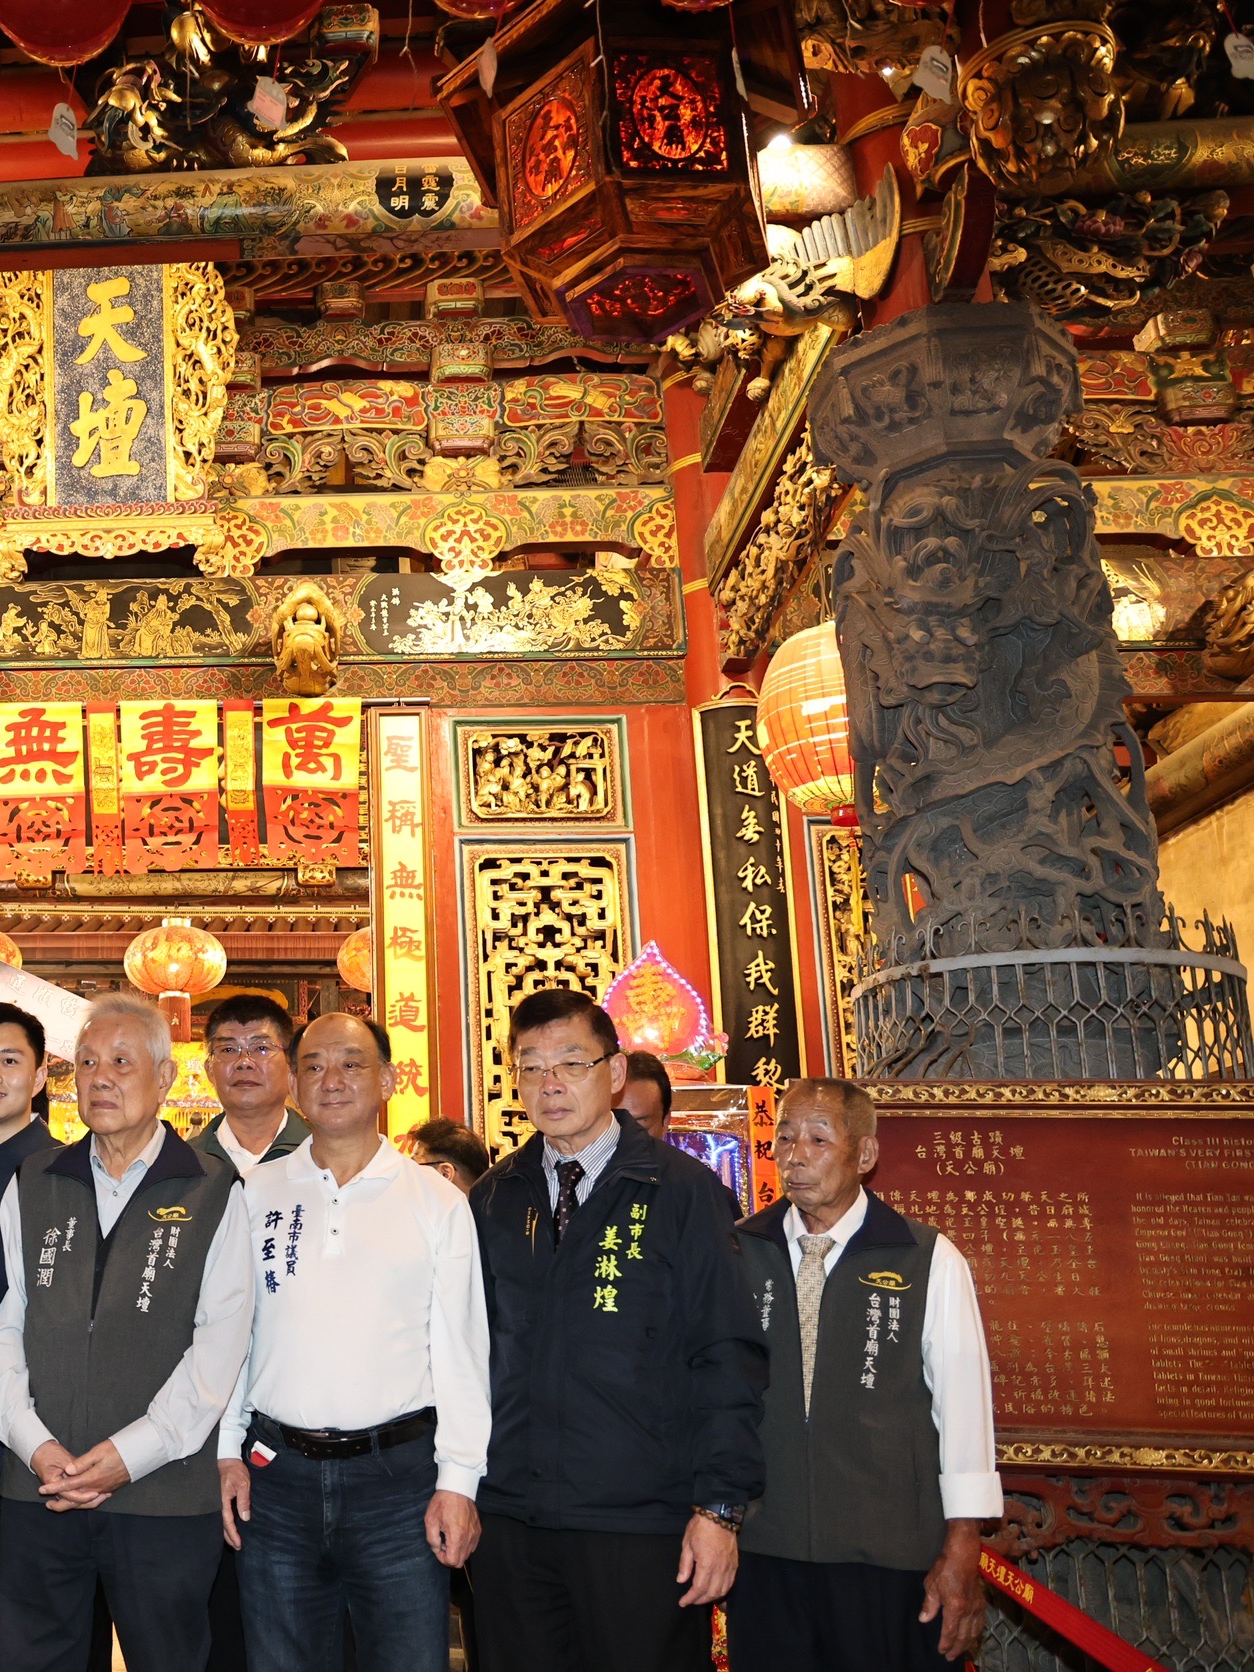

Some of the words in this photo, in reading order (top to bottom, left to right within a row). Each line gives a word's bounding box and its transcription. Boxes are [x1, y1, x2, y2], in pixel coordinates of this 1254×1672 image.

[390, 165, 409, 211] 日月明
[71, 277, 146, 478] 天壇
[751, 1099, 775, 1213] 恭祝台
[915, 1145, 1025, 1160] 台灣首廟天壇
[933, 1131, 1003, 1145] 三級古蹟
[1189, 1149, 1220, 1157] VERY
[936, 1161, 1005, 1175] (天公廟)
[36, 1227, 61, 1288] 徐國潤
[62, 1216, 78, 1252] 董事長
[163, 1226, 181, 1269] 財團法人
[262, 1210, 283, 1295] 許至椿
[285, 1204, 305, 1276] 臺南市議員
[625, 1203, 647, 1260] 副市長
[136, 1226, 164, 1313] 台灣首廟天壇
[593, 1225, 622, 1313] 姜淋煌
[860, 1292, 882, 1390] 台灣首廟天壇
[886, 1296, 901, 1343] 財團法人
